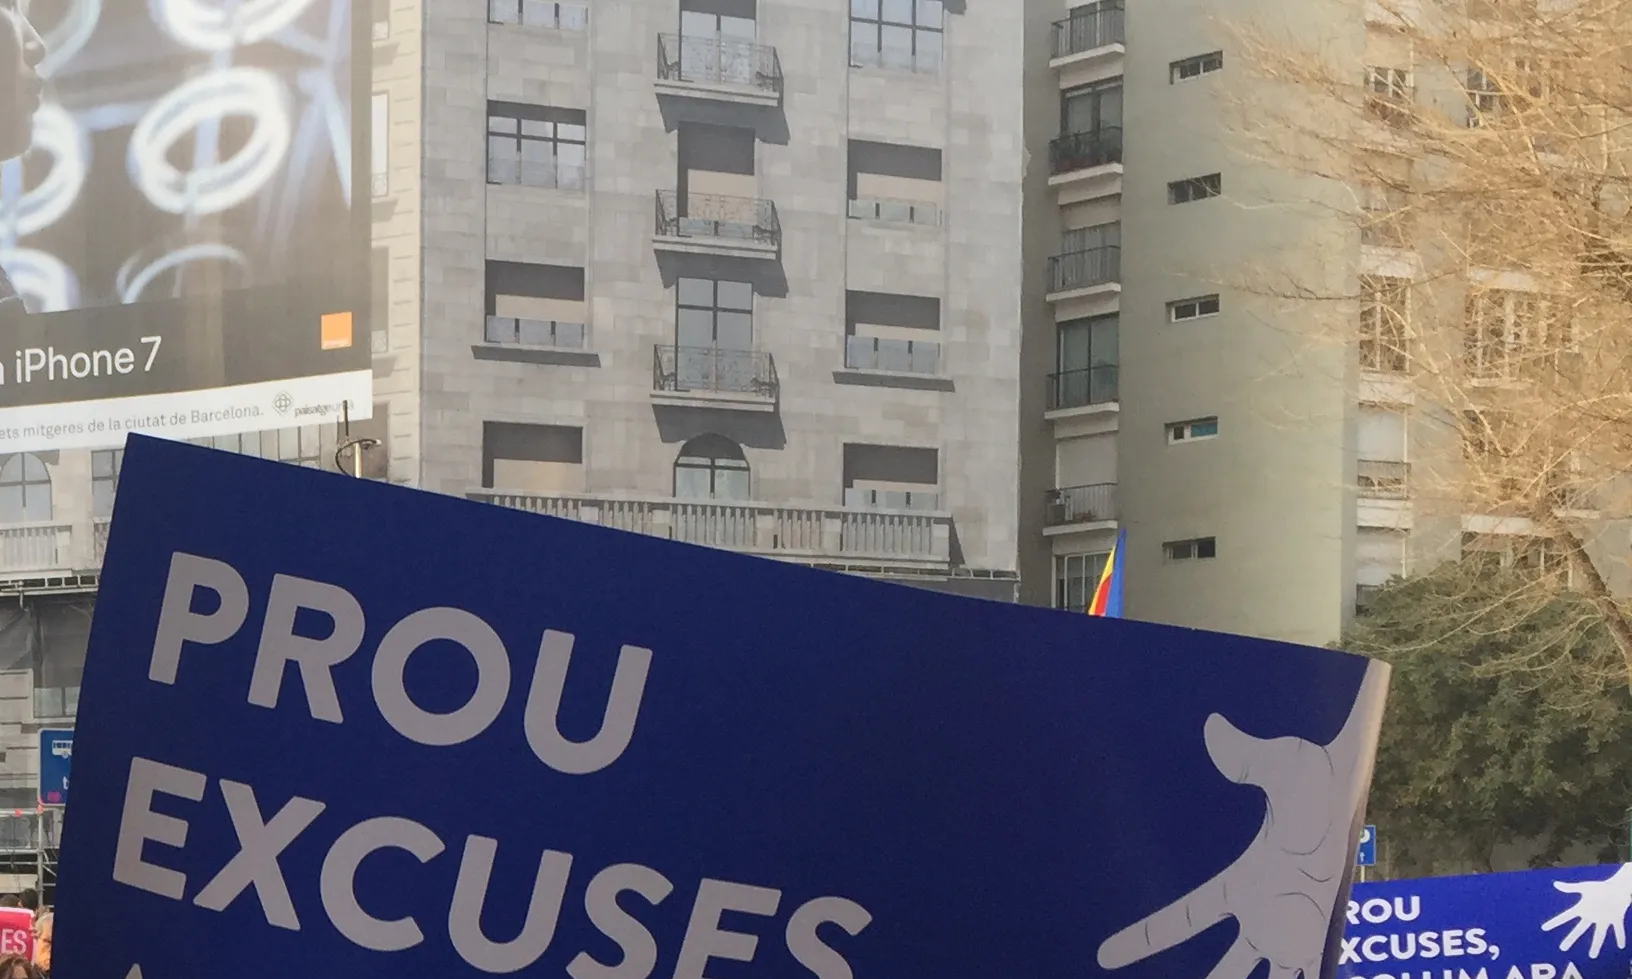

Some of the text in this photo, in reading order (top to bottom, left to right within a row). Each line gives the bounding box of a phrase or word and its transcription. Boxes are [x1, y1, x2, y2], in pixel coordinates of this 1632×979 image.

[15, 346, 134, 384] iPhone
[140, 336, 162, 372] 7
[23, 420, 83, 439] mitgeres
[88, 415, 105, 432] de
[108, 414, 121, 430] la
[124, 412, 165, 430] ciutat
[169, 411, 187, 426] de
[190, 405, 264, 424] Barcelona.
[148, 551, 653, 775] PROU
[1345, 896, 1420, 925] ROU
[1338, 928, 1500, 964] XCUSES,
